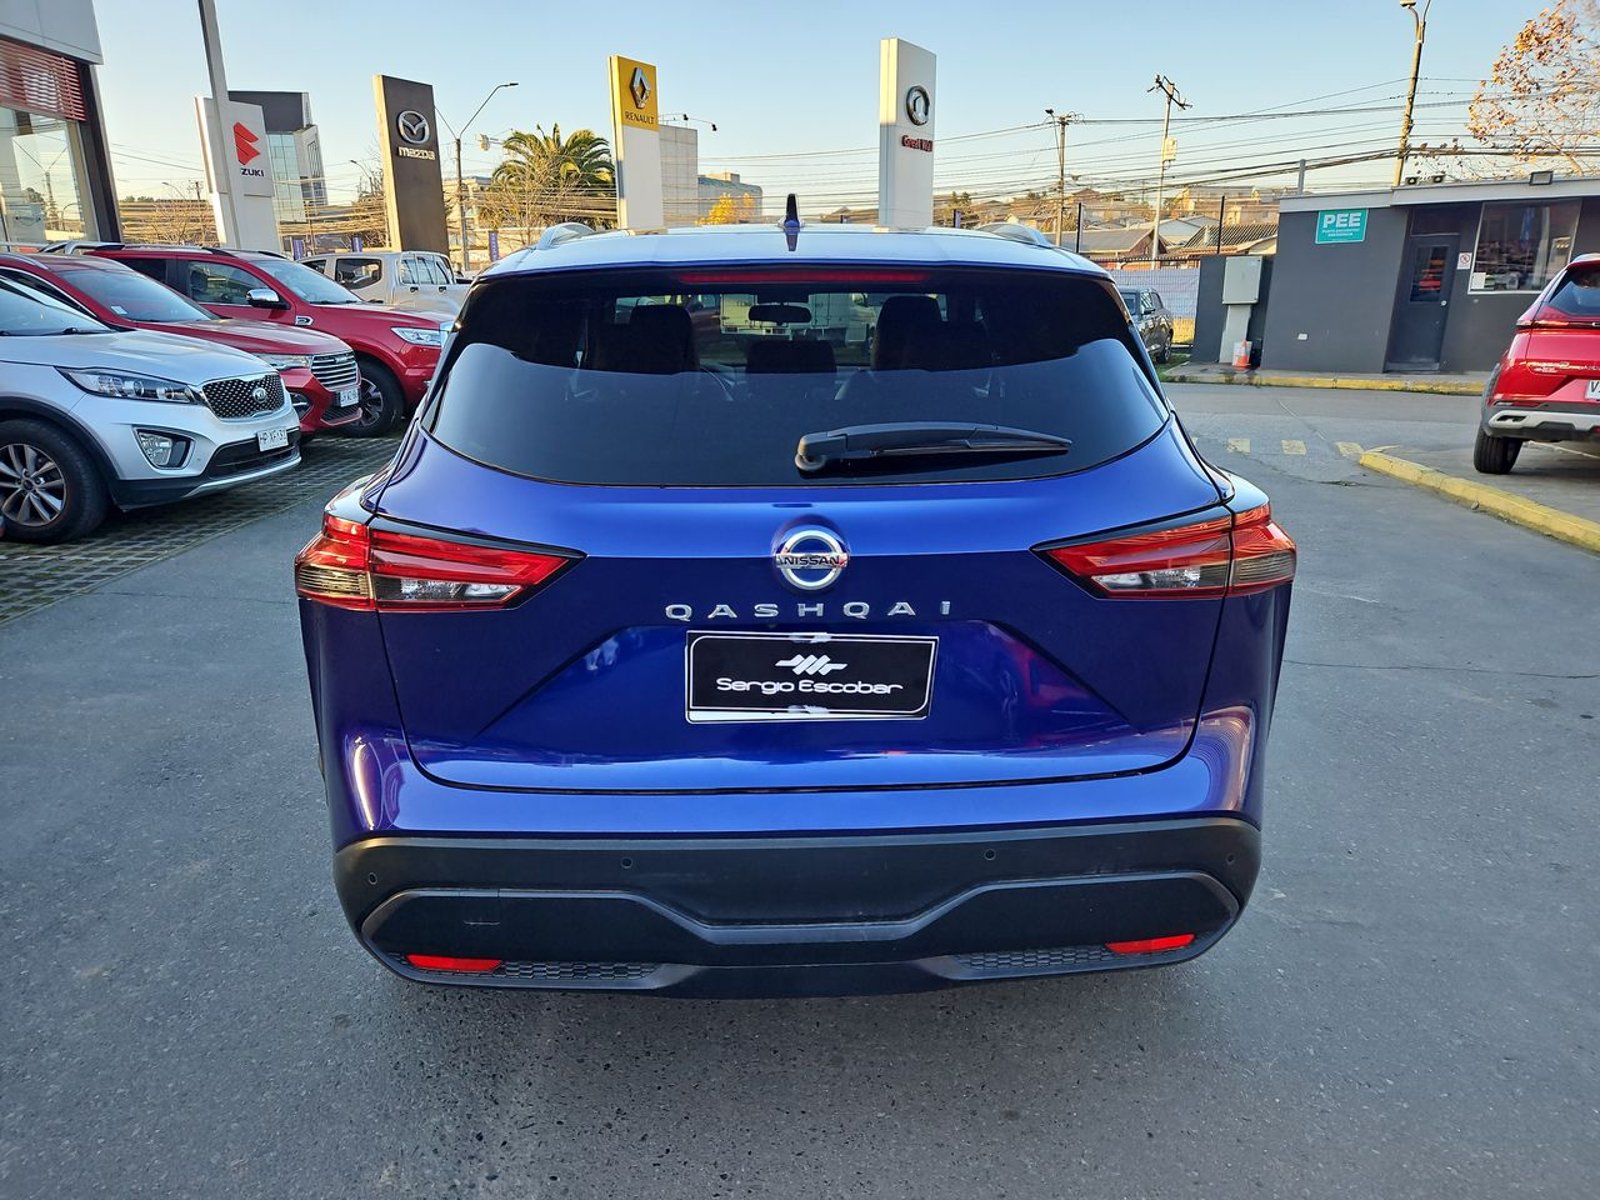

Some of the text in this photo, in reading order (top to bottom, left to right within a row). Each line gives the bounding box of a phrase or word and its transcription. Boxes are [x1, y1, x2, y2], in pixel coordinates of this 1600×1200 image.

[624, 110, 656, 124] RENAULT
[397, 146, 435, 160] mazda
[240, 167, 265, 177] ZUKI
[1322, 212, 1361, 228] PEE
[783, 556, 840, 566] NISSAN
[665, 601, 952, 622] QASHQAI
[715, 677, 904, 696] Sergio Escobar
